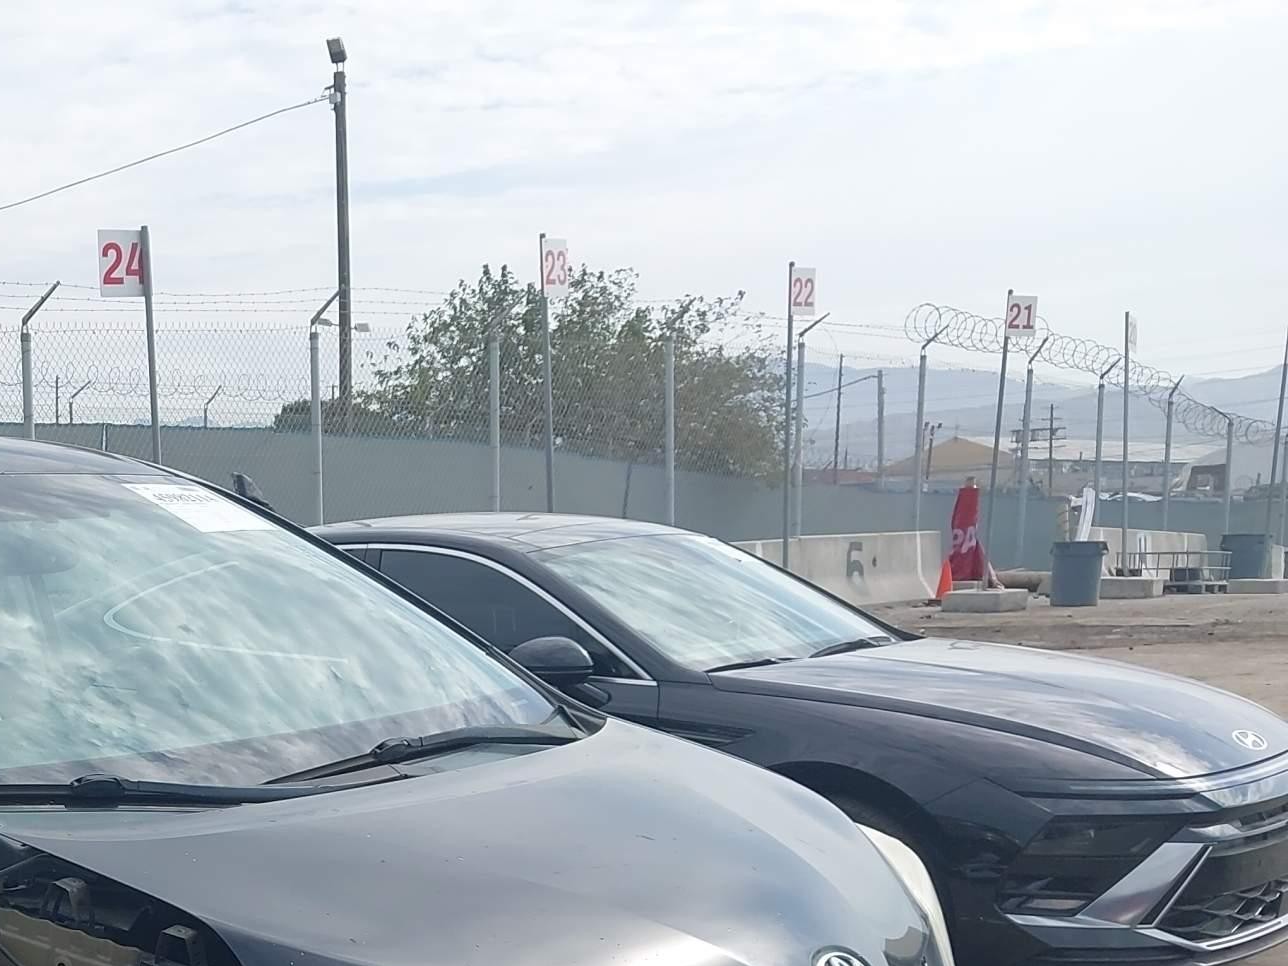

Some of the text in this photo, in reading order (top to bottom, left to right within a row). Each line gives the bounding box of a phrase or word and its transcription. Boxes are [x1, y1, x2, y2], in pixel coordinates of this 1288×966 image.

[101, 242, 144, 286] 24
[545, 249, 567, 286] 23
[792, 277, 815, 307] 22
[1007, 303, 1034, 330] 21
